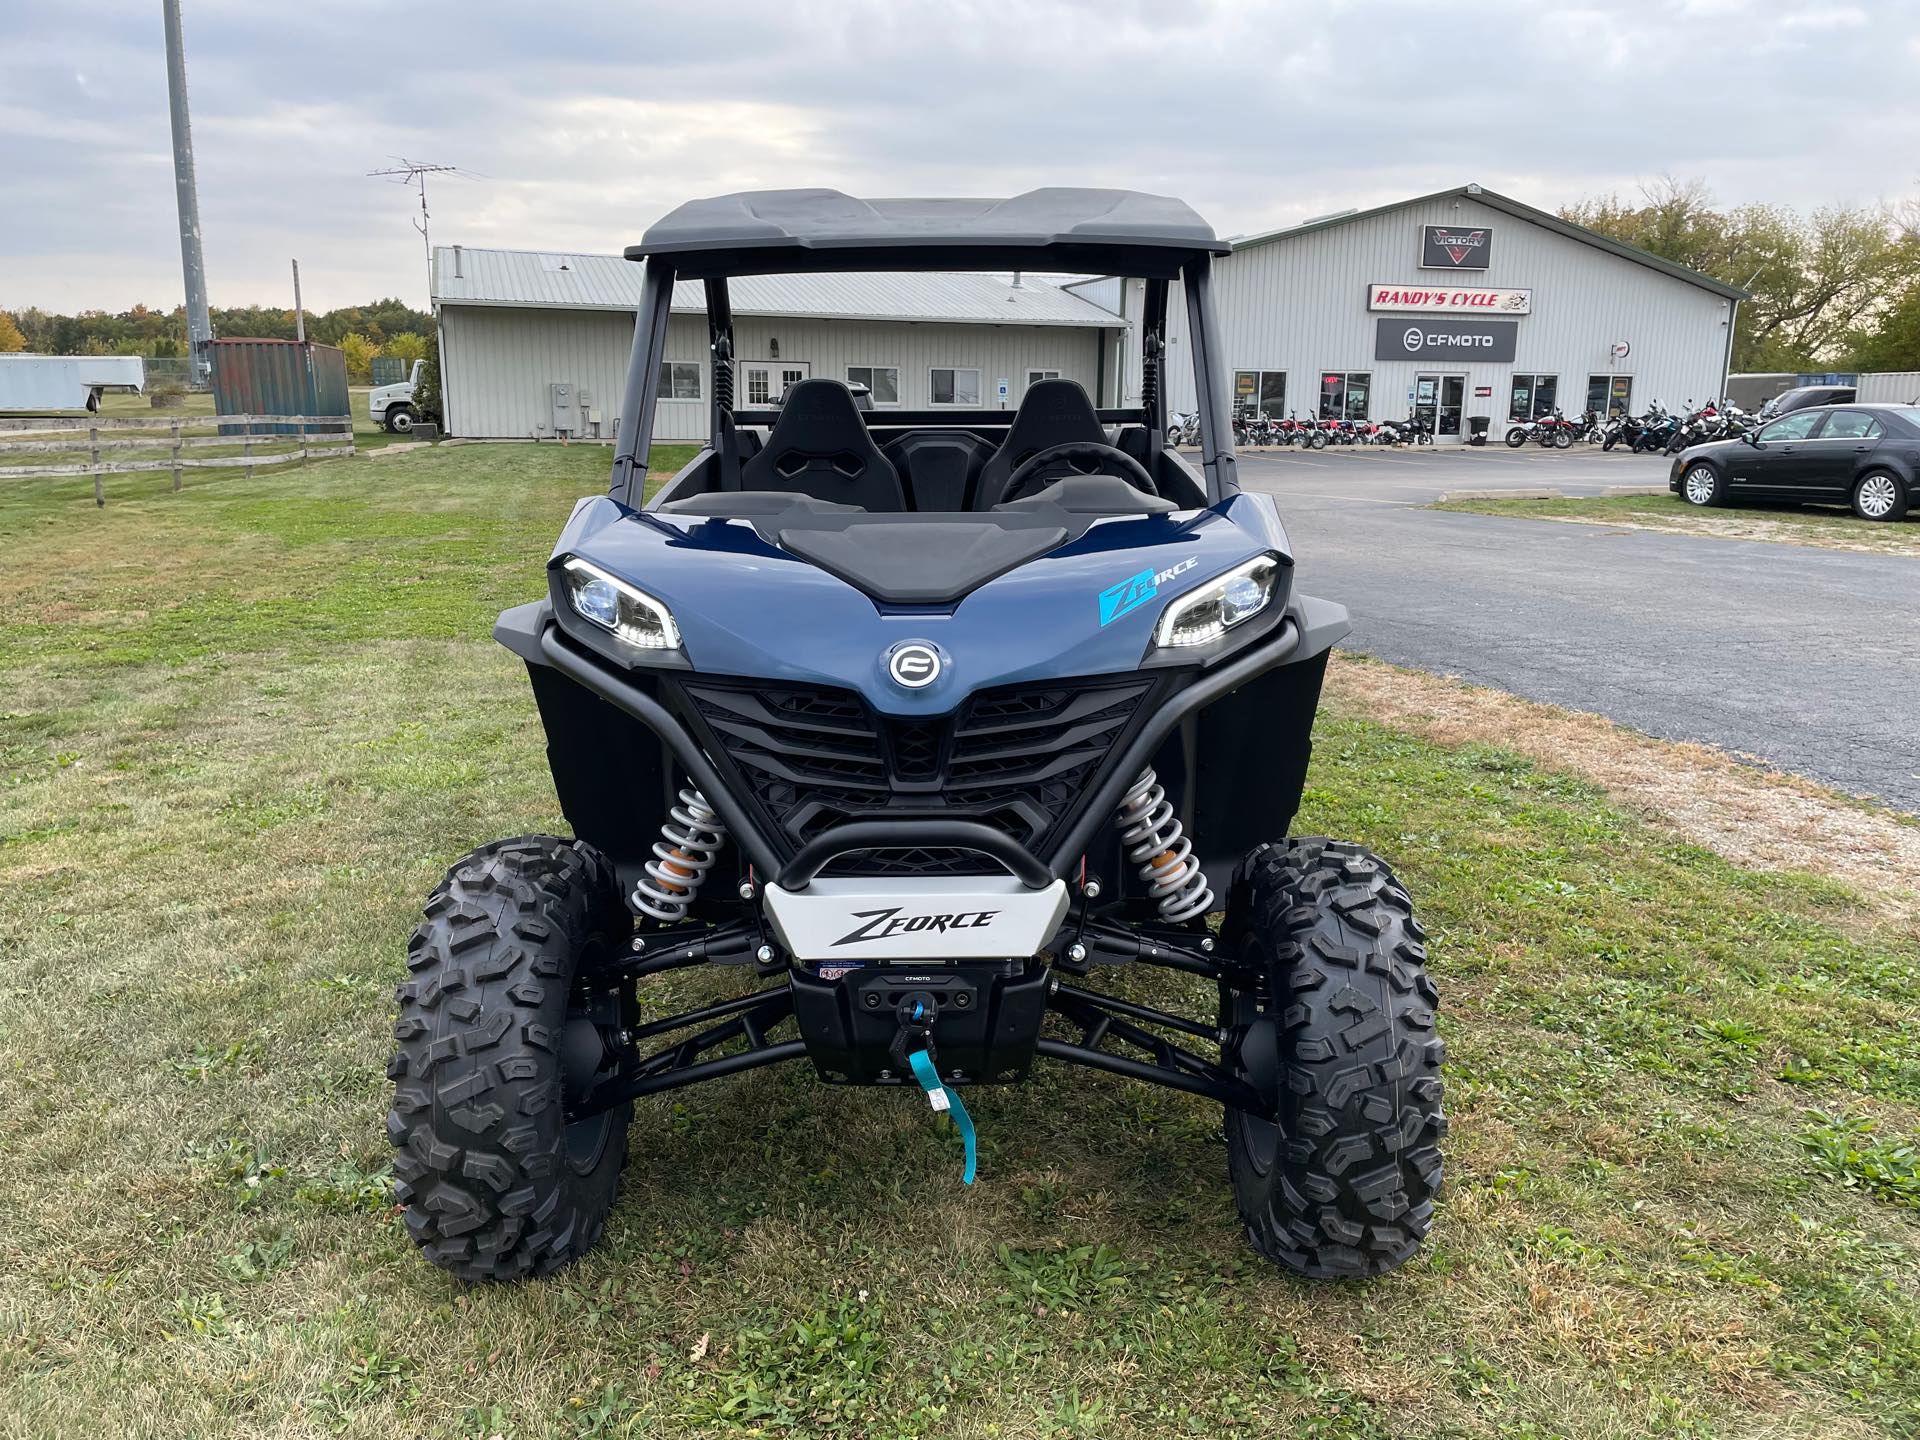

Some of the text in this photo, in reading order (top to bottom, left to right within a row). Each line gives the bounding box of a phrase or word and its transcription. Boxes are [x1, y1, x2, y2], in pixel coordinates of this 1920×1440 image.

[1434, 235, 1484, 246] VICTORY
[1375, 290, 1498, 306] RANDY'S CYCLE
[1426, 334, 1494, 347] CFMOTO
